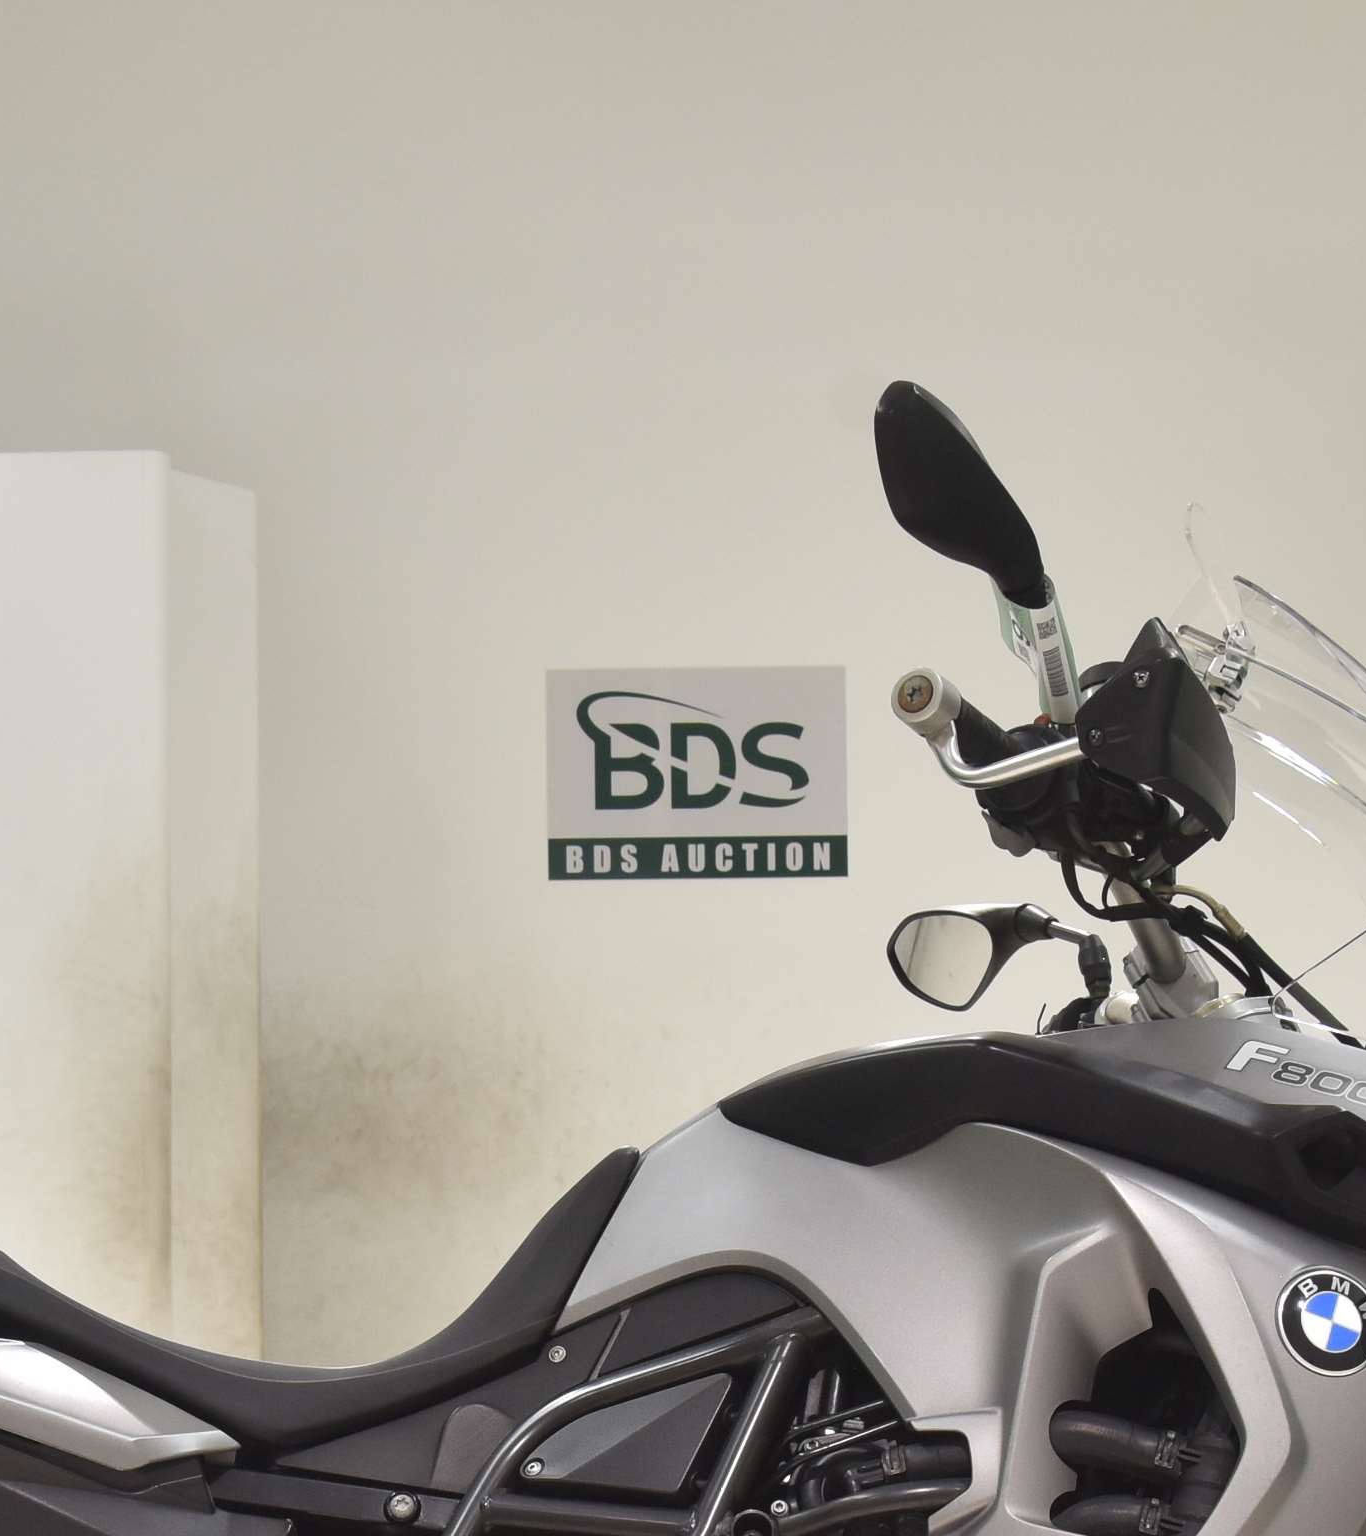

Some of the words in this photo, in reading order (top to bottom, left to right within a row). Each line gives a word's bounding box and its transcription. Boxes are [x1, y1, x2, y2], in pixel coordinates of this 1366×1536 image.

[577, 691, 810, 810] BDS
[566, 844, 638, 874] BDS
[661, 841, 831, 873] AUCTION
